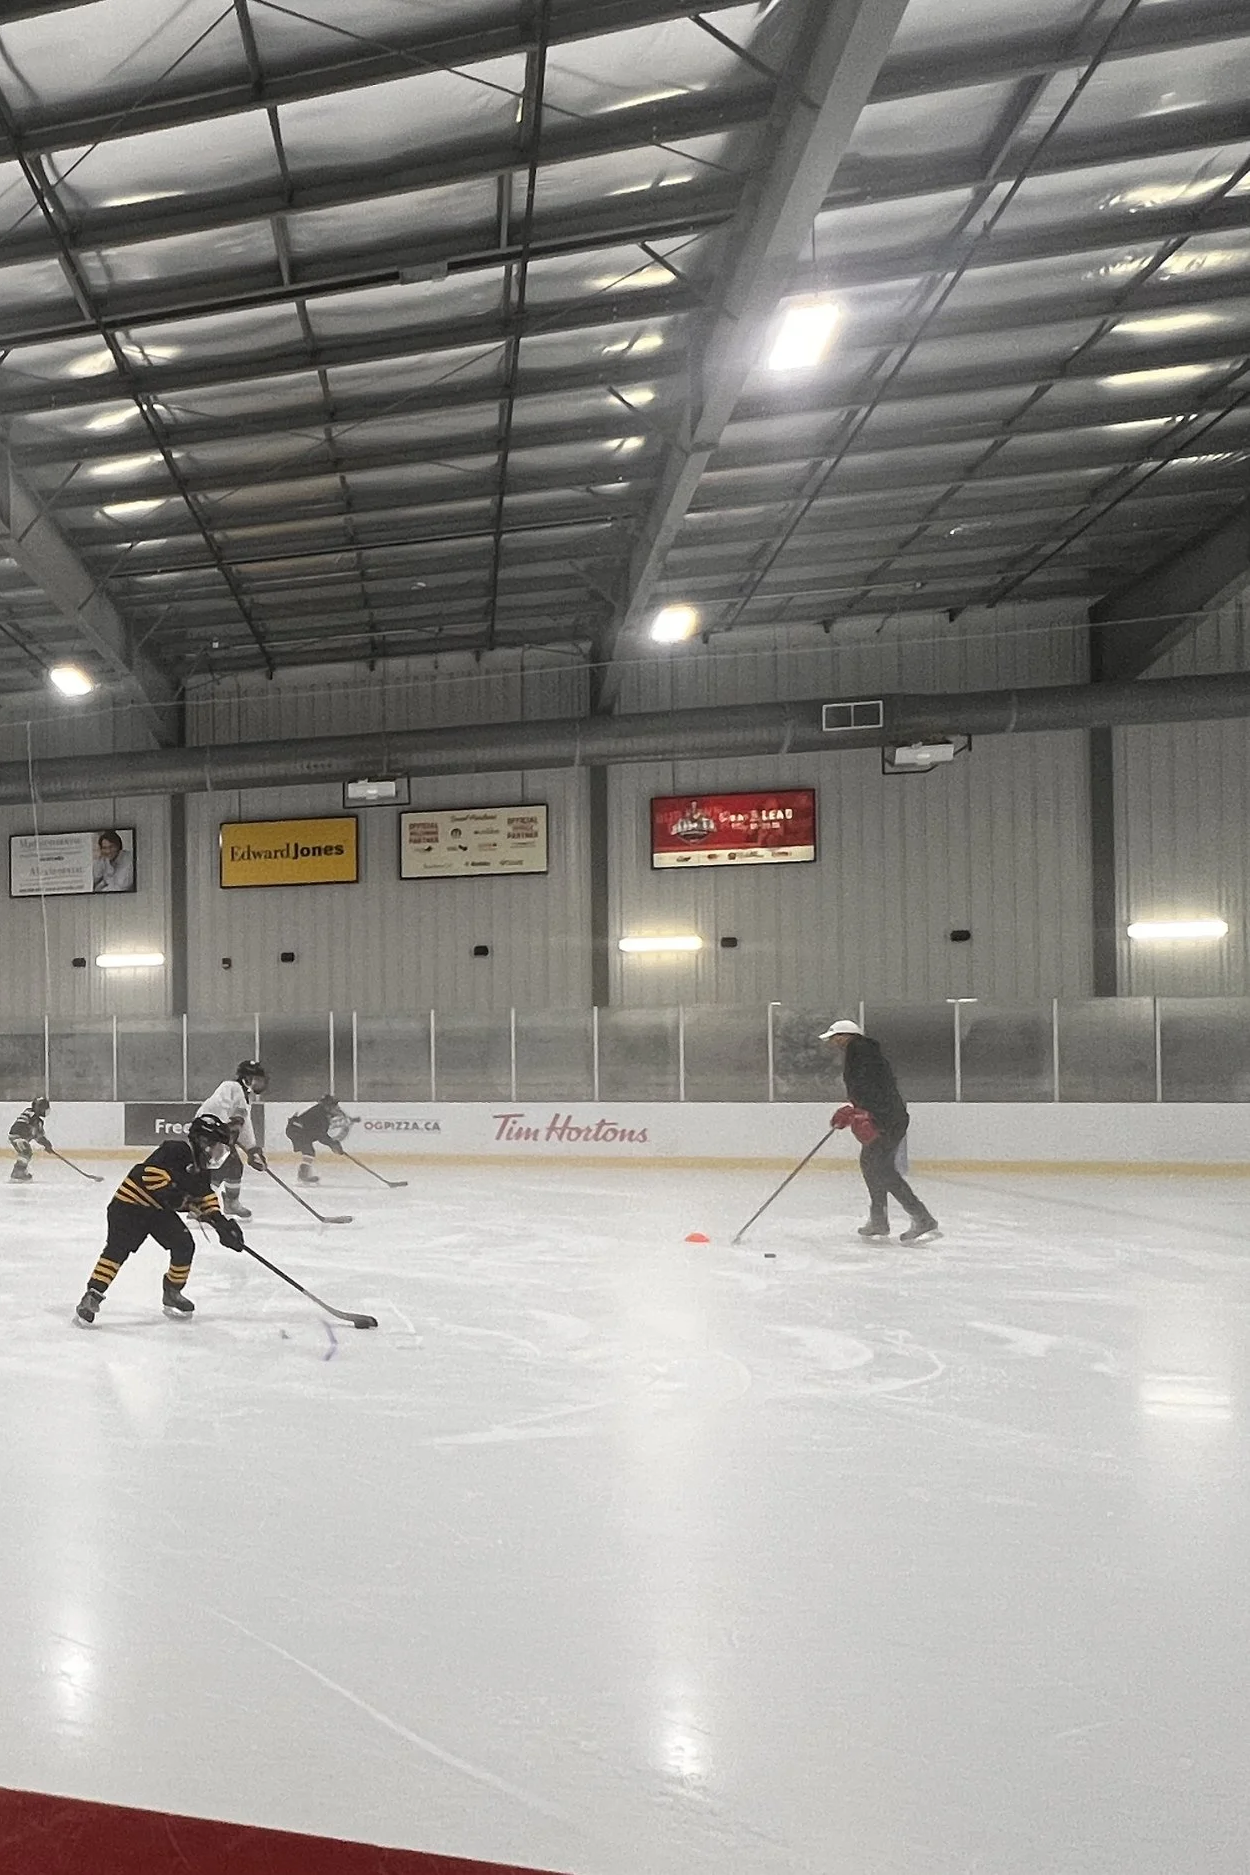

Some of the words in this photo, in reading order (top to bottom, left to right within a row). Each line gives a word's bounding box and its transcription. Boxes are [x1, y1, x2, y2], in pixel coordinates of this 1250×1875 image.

[230, 843, 290, 861] Edward
[292, 843, 344, 859] Jones
[493, 1113, 538, 1141] Tim
[545, 1113, 648, 1143] Hortons
